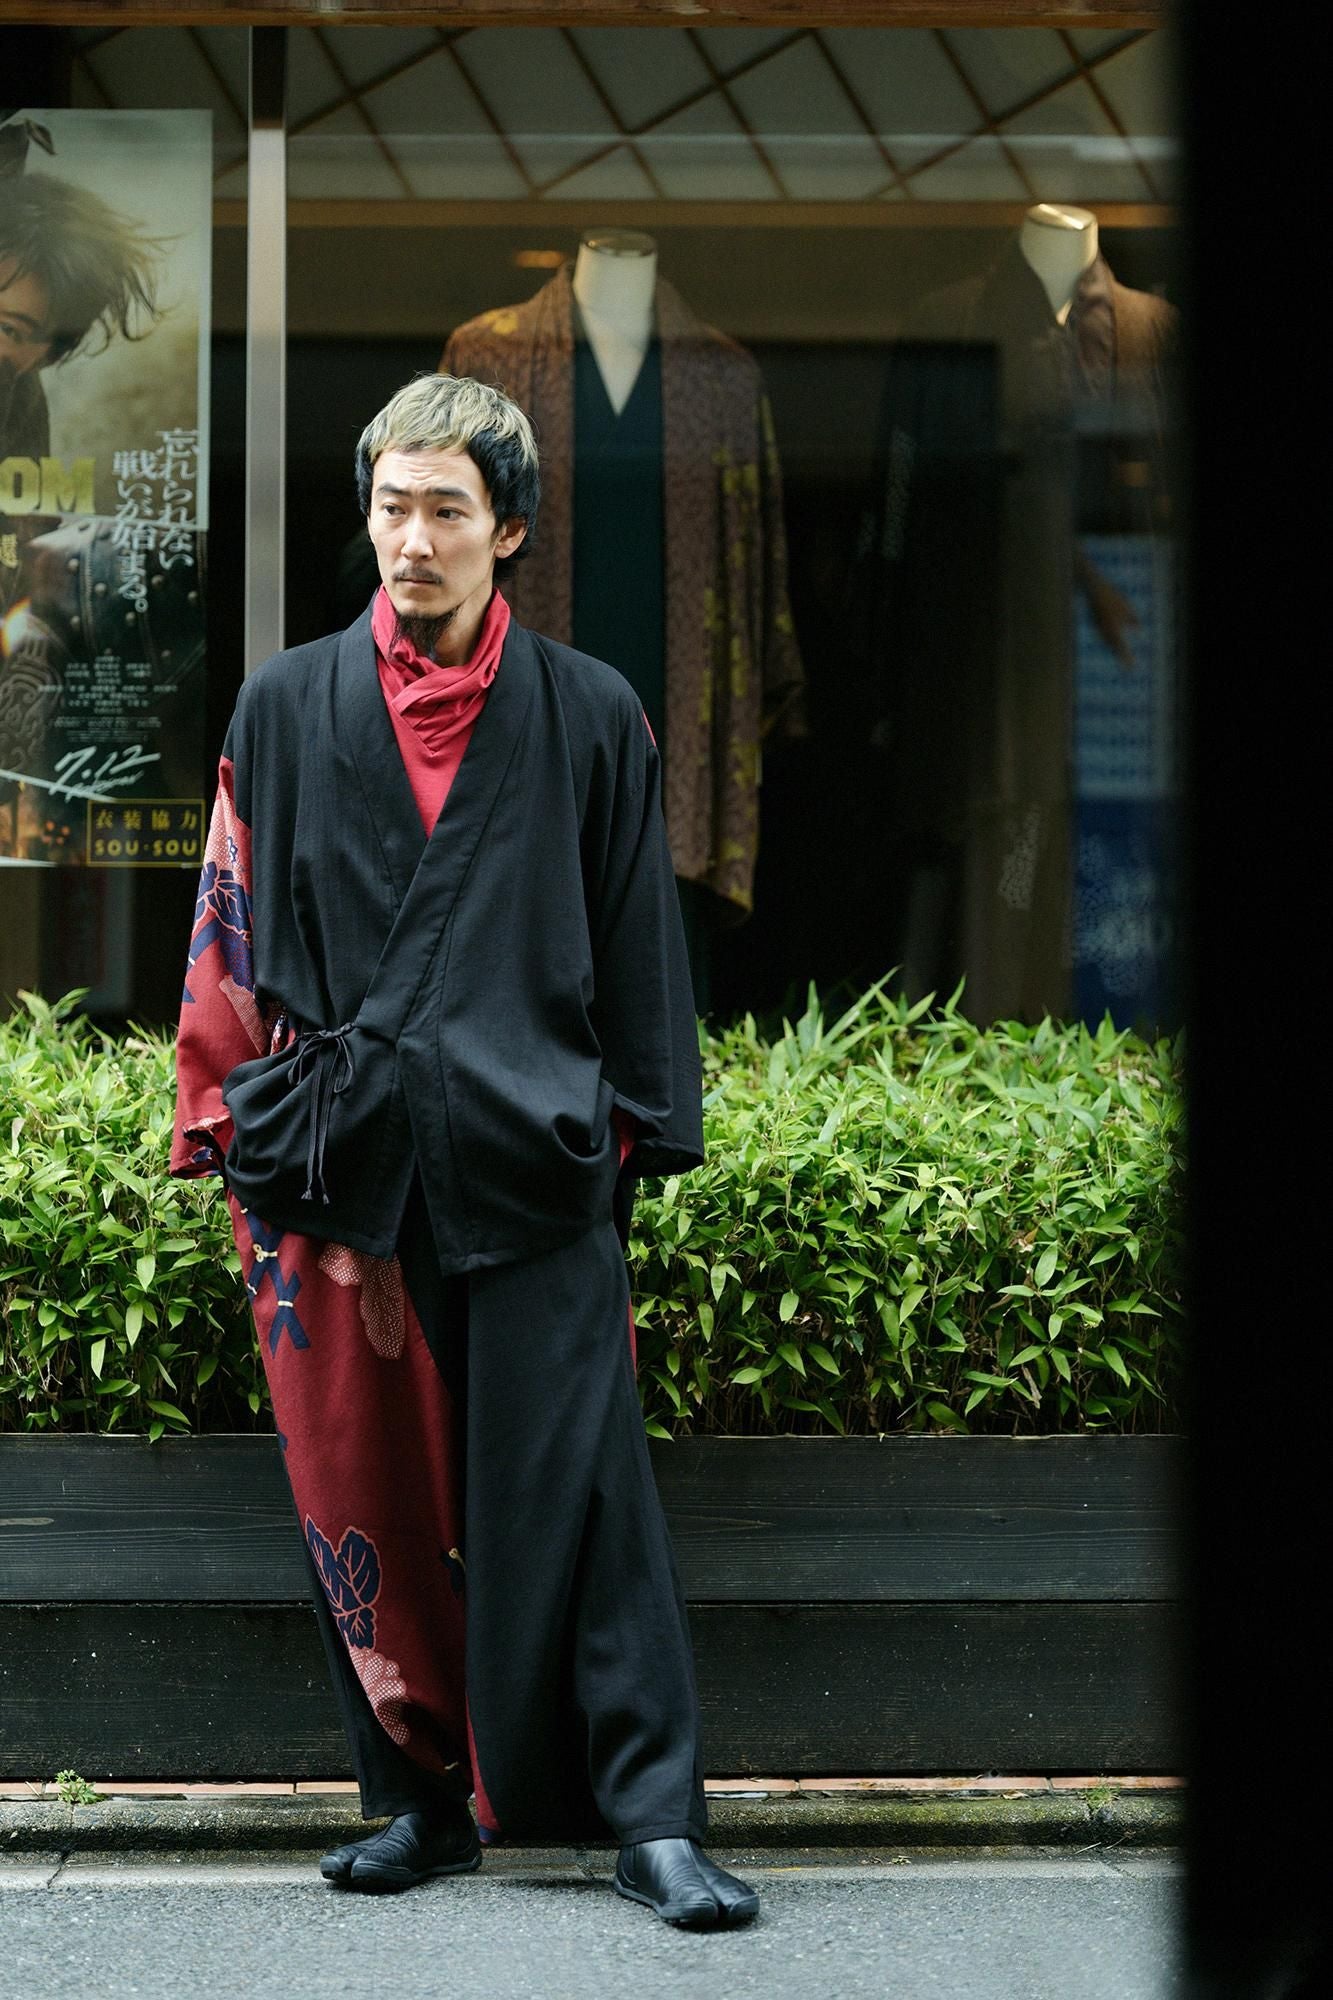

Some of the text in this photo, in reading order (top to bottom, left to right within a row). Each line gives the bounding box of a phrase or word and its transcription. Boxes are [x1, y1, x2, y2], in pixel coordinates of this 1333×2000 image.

[111, 450, 158, 613] 戦いが始まる。
[157, 427, 199, 570] 忘れられない
[48, 744, 161, 796] 7.12
[95, 809, 198, 831] 衣装協力
